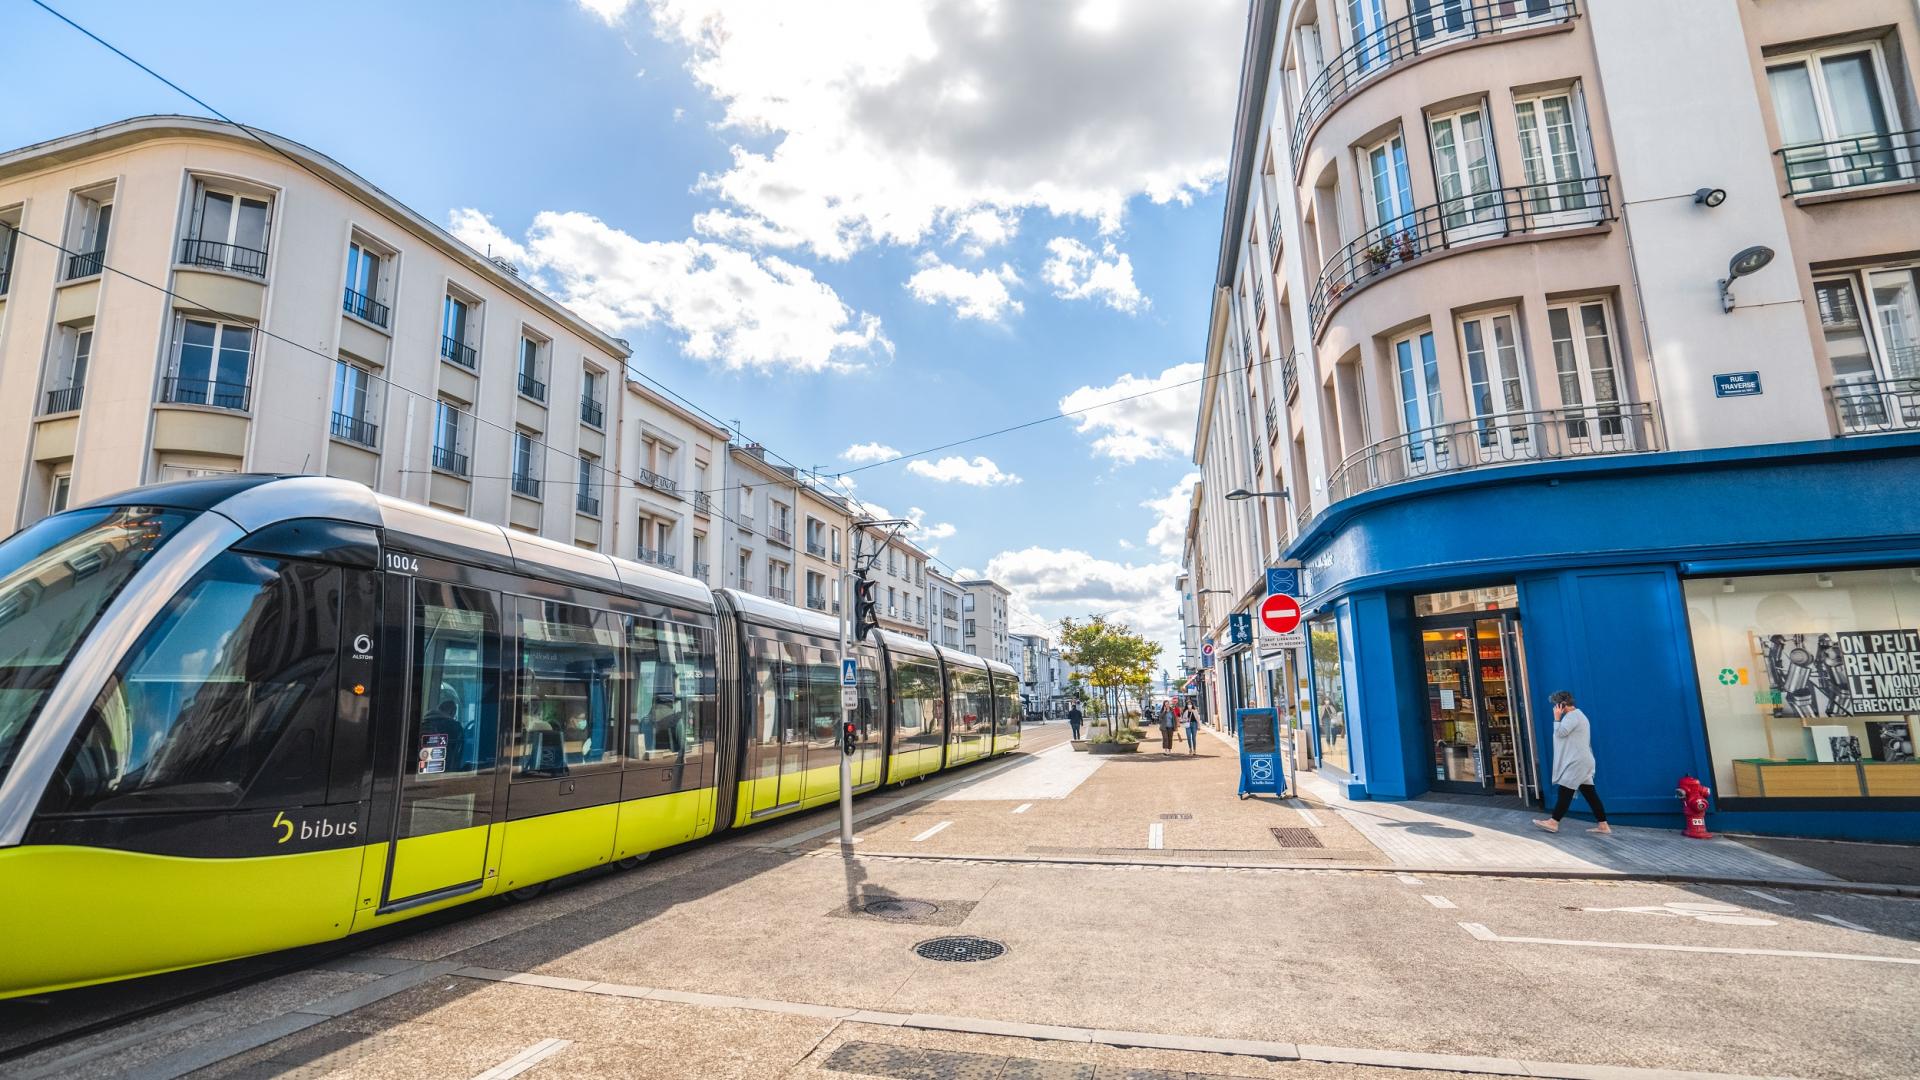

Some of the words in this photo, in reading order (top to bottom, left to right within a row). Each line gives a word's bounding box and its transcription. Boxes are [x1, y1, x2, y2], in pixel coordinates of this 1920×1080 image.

[1721, 382, 1756, 390] TRAVERSE
[386, 553, 419, 573] 1004
[1840, 635, 1866, 654] ON
[1870, 633, 1917, 653] PEUT
[1843, 652, 1920, 675] RENDRE
[300, 818, 358, 840] bibus
